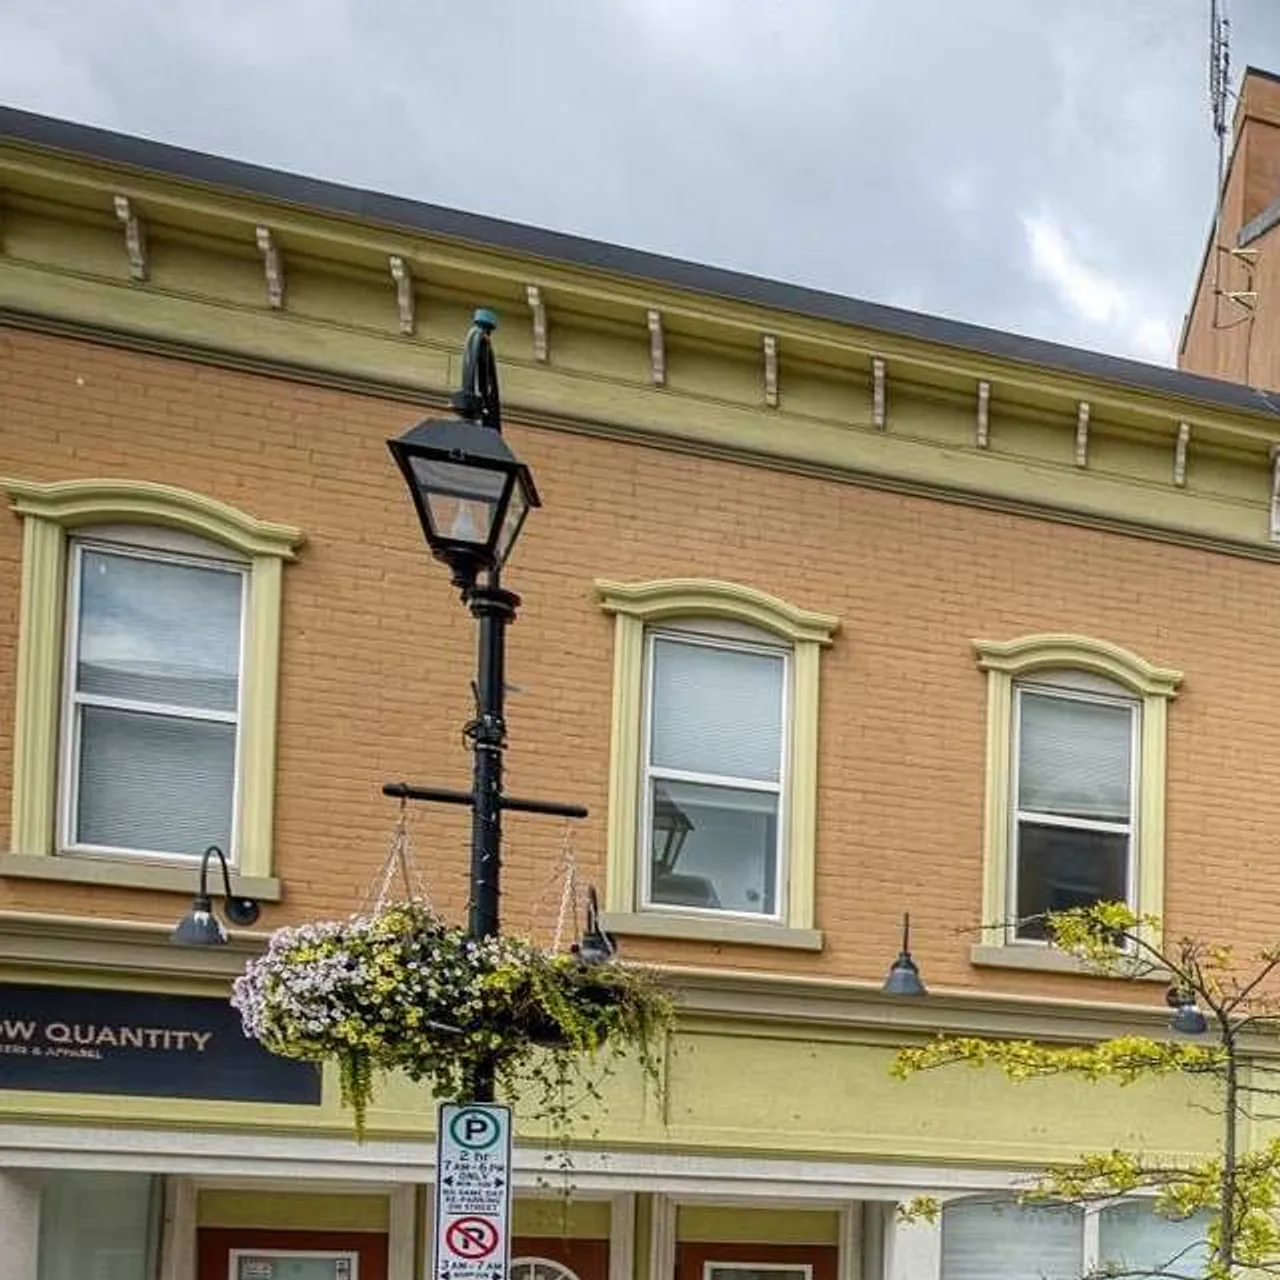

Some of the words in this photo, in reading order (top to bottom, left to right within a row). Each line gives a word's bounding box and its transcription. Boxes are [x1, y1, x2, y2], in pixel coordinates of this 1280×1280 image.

[45, 1022, 212, 1051] QUANTITY
[465, 1119, 488, 1140] P
[460, 1150, 469, 1161] 2
